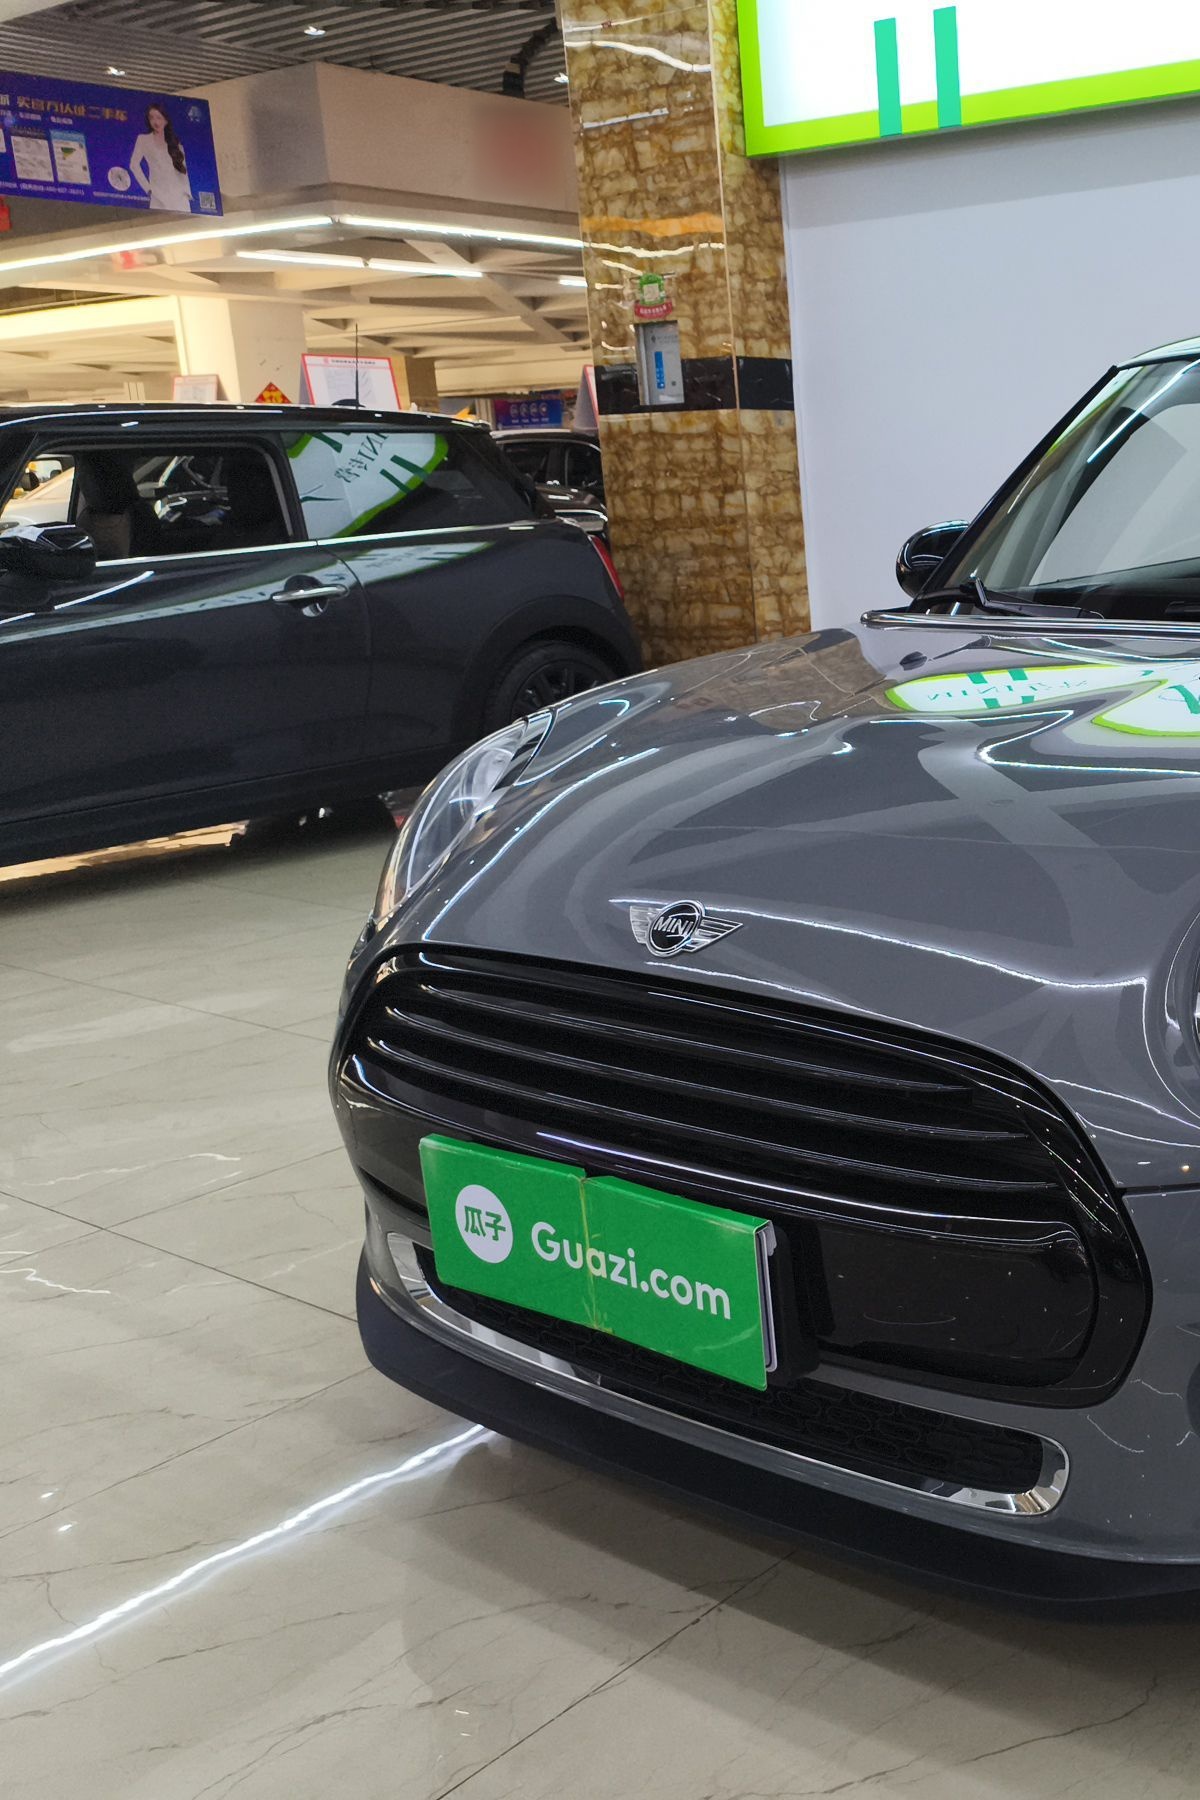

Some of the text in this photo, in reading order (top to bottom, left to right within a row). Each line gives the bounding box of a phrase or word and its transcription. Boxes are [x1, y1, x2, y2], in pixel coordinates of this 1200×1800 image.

[653, 915, 695, 937] MINI
[464, 1205, 507, 1242] 瓜子
[531, 1221, 732, 1321] Guazi.com
